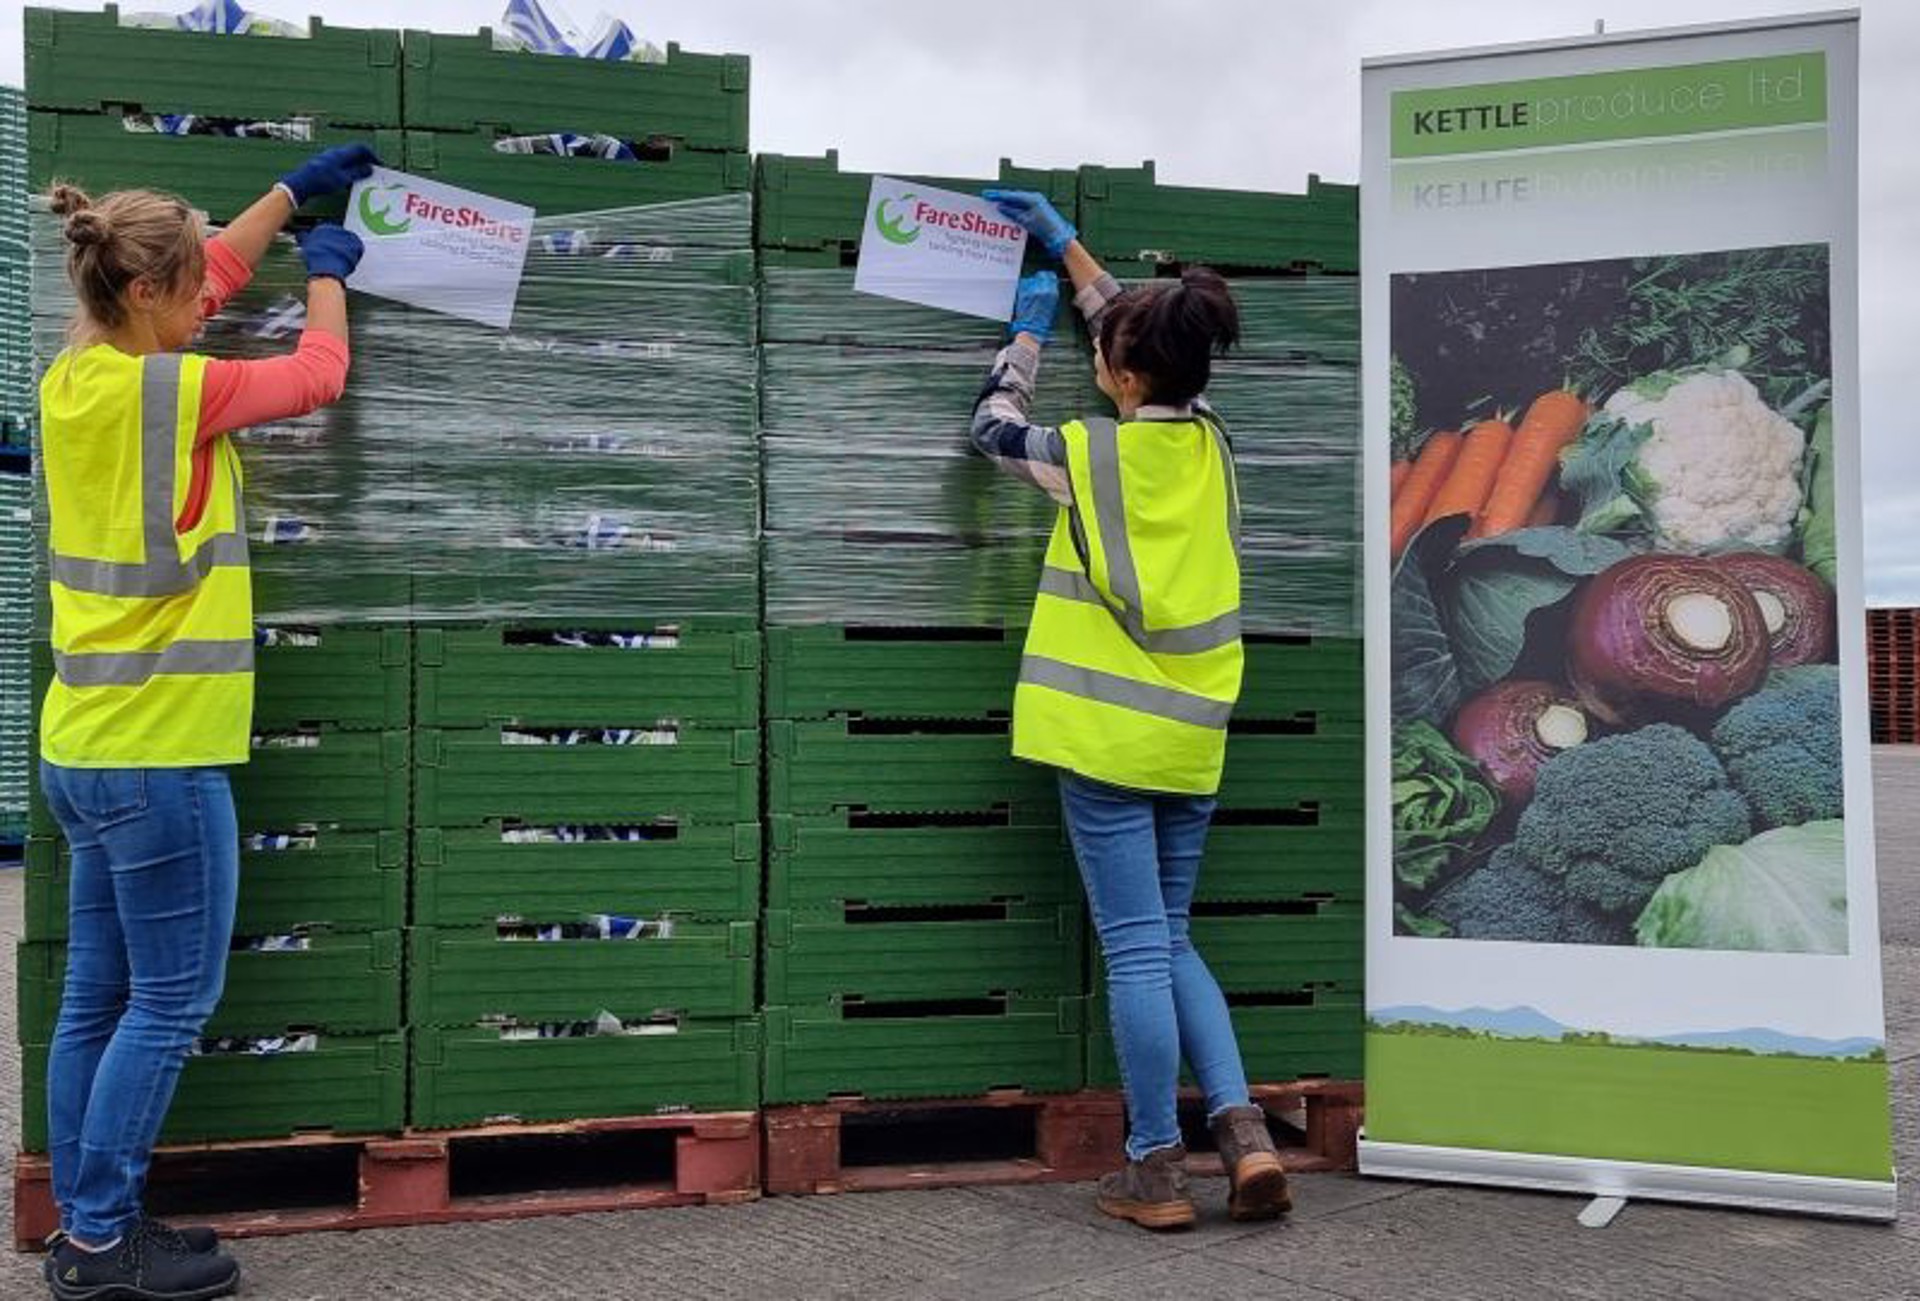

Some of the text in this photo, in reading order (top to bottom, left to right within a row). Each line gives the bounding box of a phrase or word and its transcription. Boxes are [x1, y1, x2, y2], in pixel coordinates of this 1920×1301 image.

[1414, 102, 1528, 135] KETTLE
[1750, 62, 1802, 106] ltd
[915, 201, 1021, 241] FareShare
